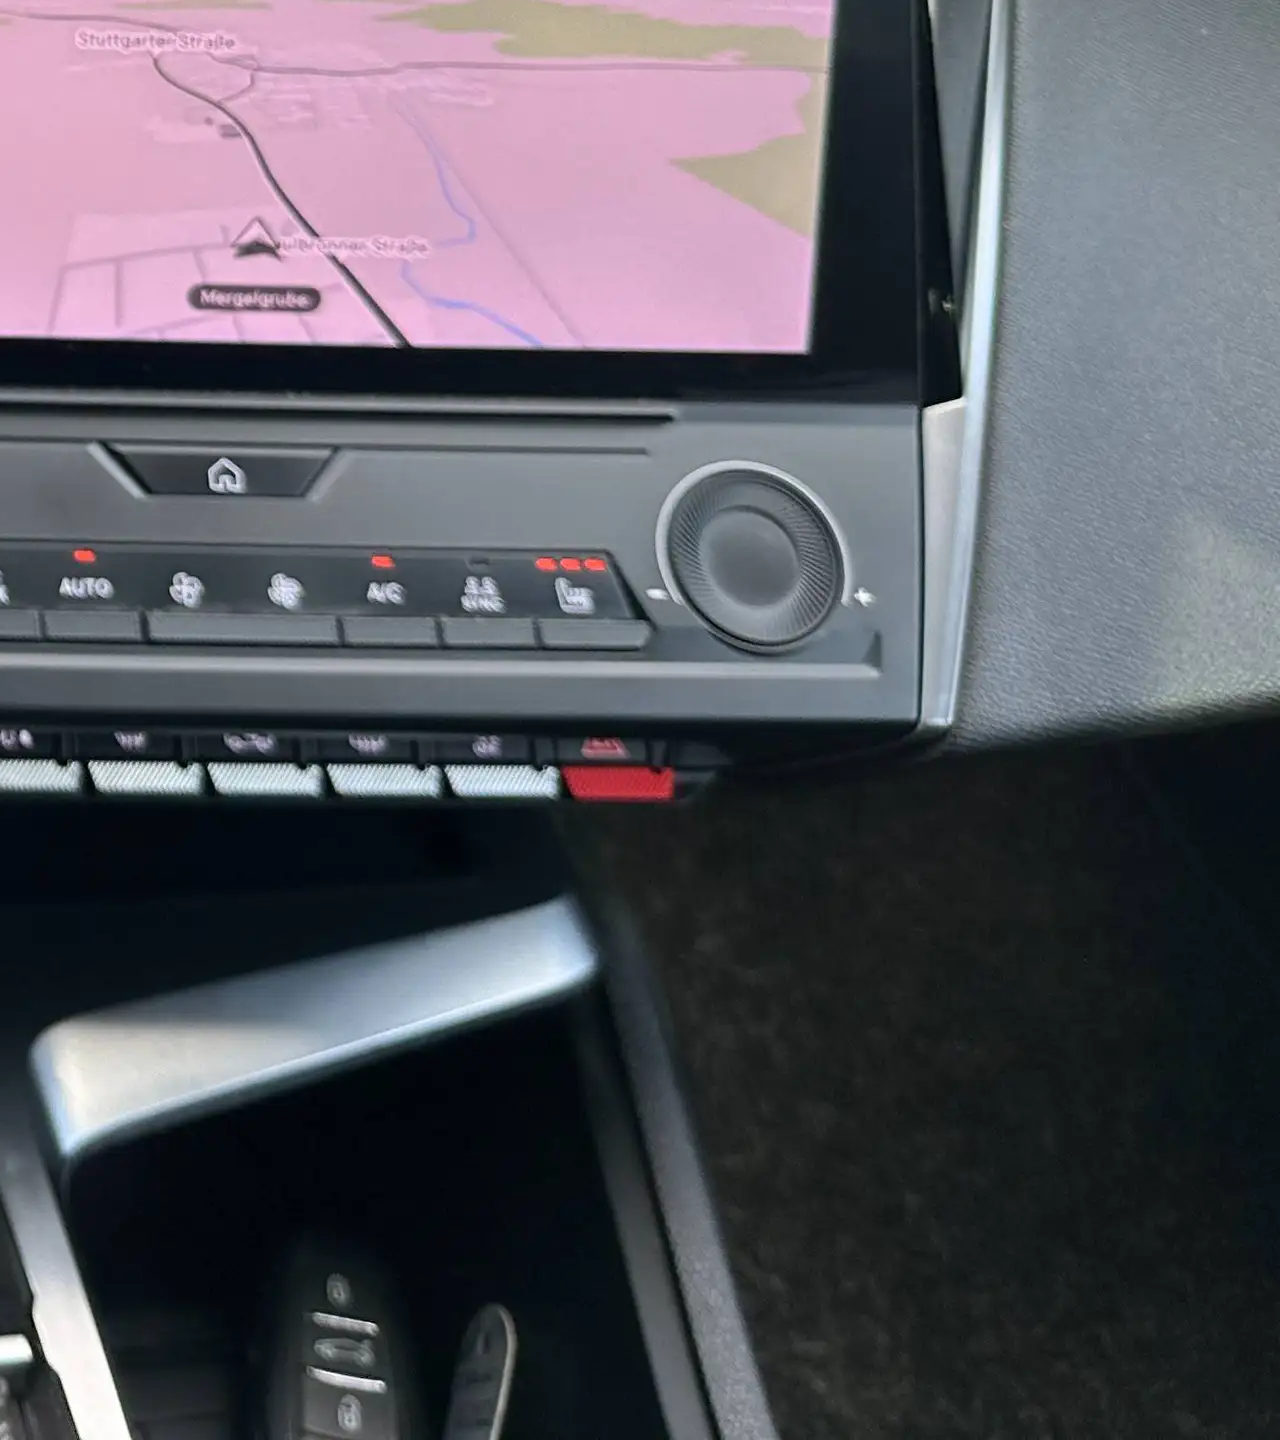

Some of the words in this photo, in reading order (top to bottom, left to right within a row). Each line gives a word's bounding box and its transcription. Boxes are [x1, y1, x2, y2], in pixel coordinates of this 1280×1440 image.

[177, 32, 236, 51] Straße
[198, 288, 312, 310] Mergelgrube
[58, 576, 115, 600] AUTO
